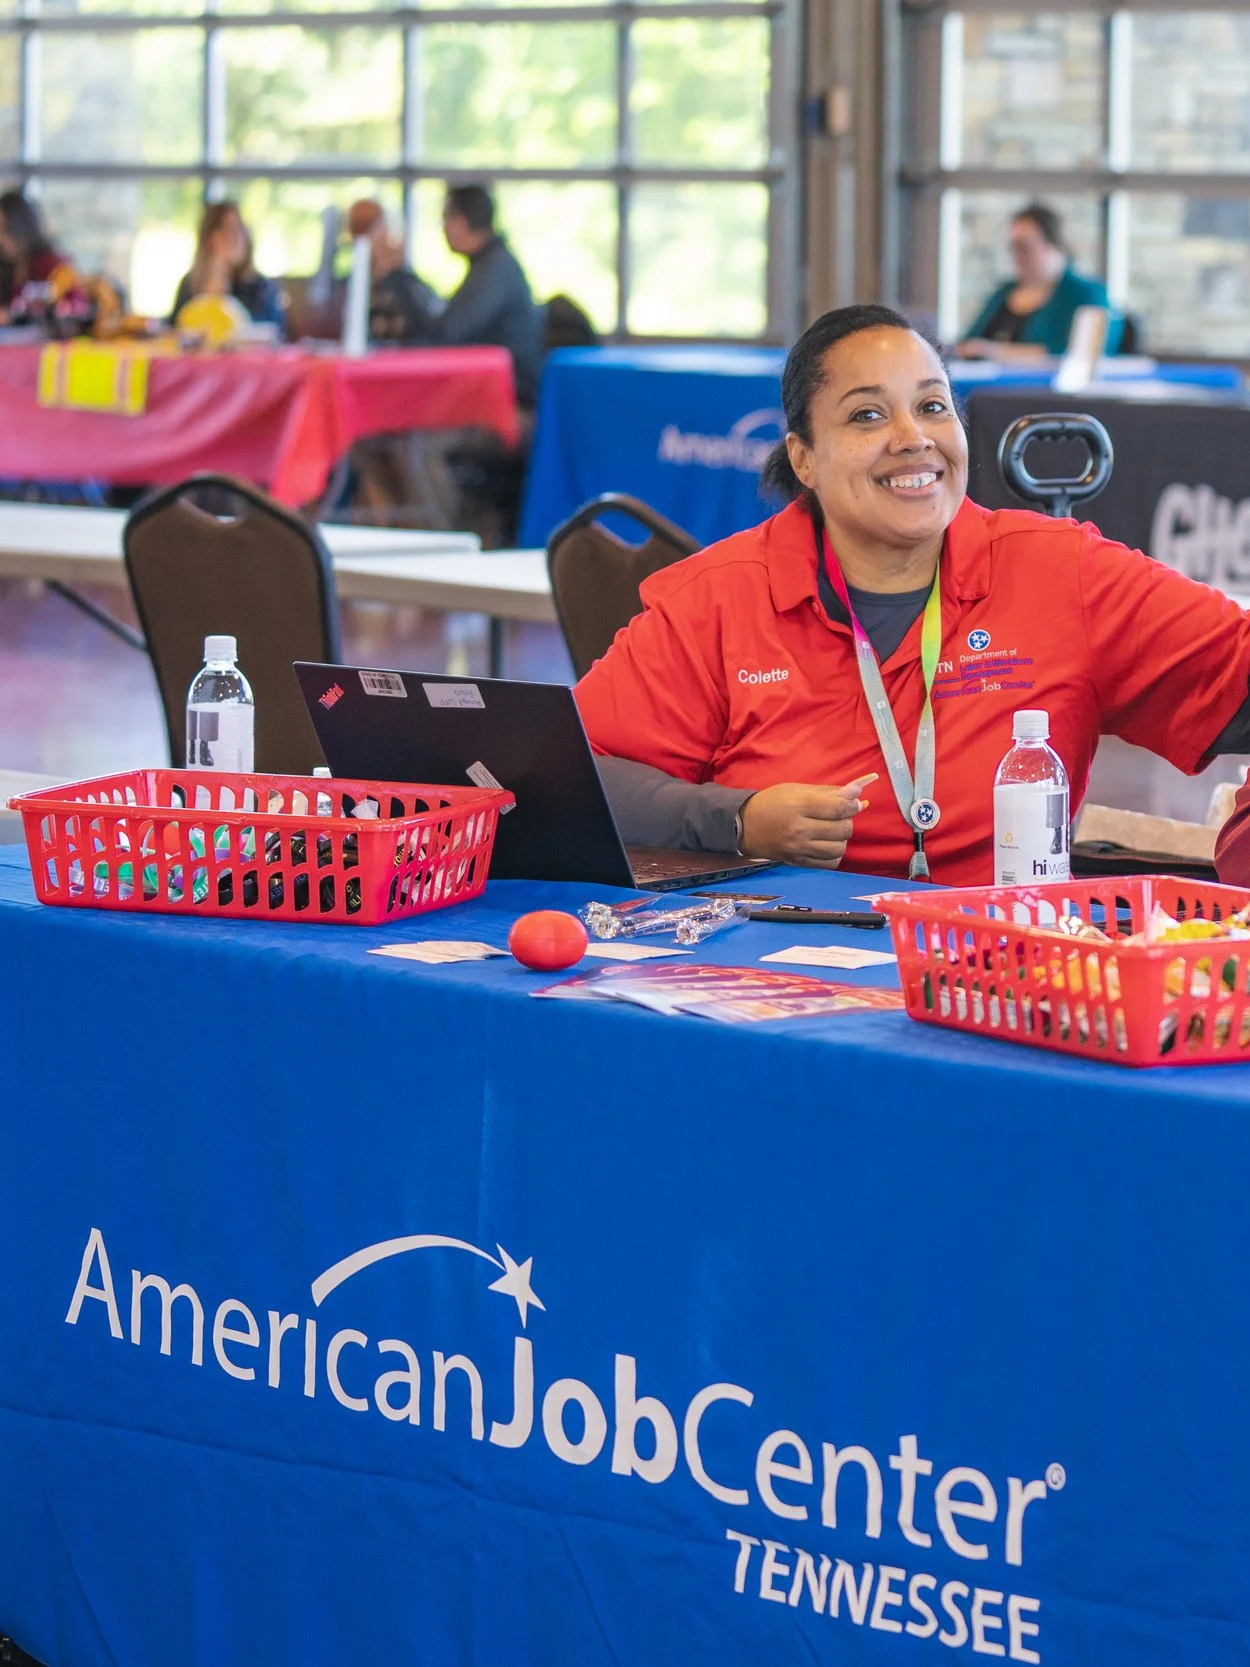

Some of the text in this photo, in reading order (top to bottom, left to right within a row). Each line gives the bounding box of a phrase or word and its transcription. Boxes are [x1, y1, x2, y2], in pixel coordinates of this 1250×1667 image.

[960, 648, 1017, 663] Department of
[937, 660, 953, 673] TN
[738, 668, 789, 684] Colette
[1033, 860, 1047, 875] hi
[727, 1530, 1039, 1663] TENNESSEE
